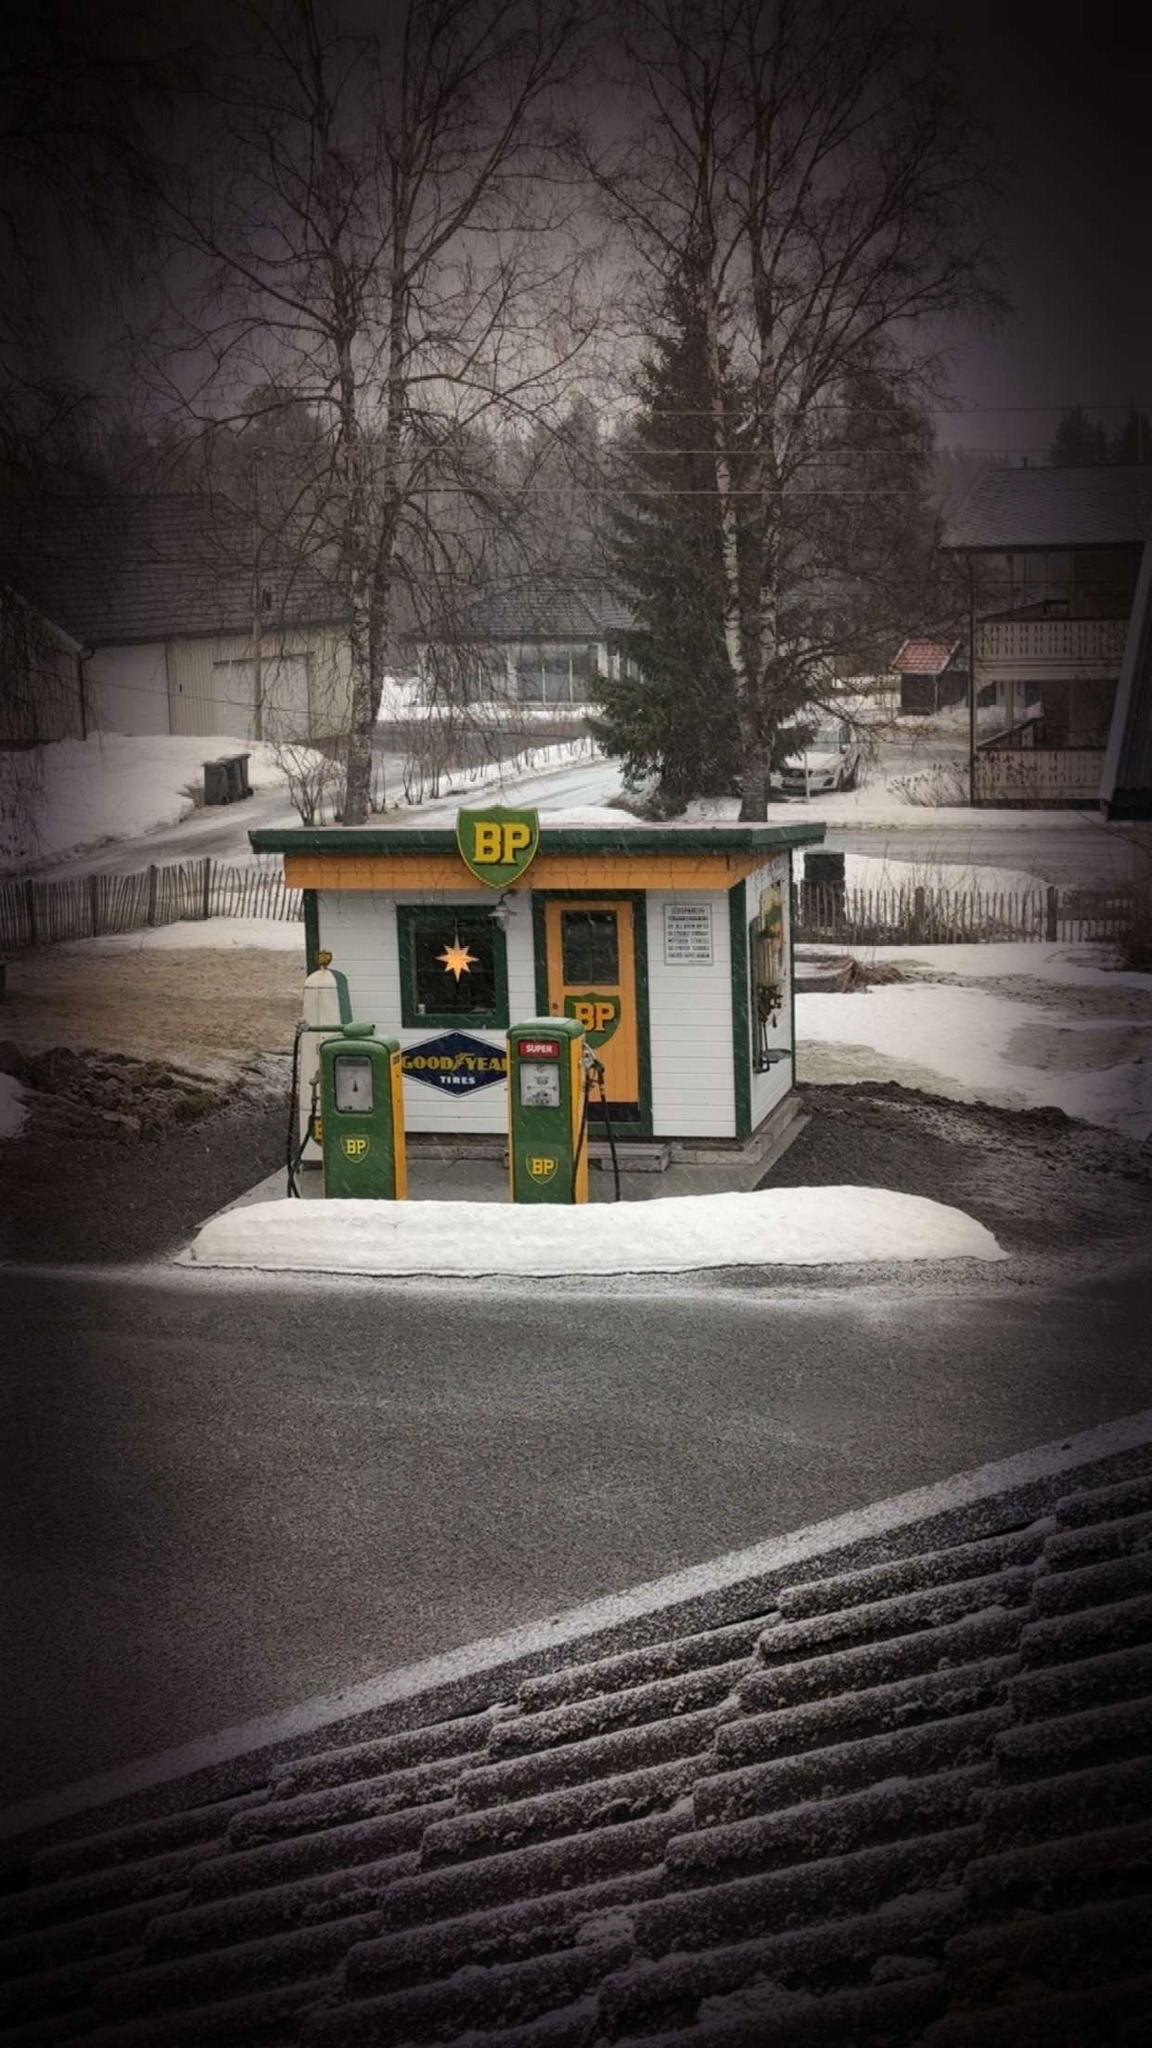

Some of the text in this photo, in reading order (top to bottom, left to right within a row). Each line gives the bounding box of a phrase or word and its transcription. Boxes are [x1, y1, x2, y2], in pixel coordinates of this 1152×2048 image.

[473, 822, 532, 866] BP
[573, 1002, 615, 1032] BP
[526, 1044, 553, 1053] SUPER
[440, 1076, 475, 1085] TIRES
[346, 1139, 366, 1155] BP
[532, 1158, 555, 1175] BP
